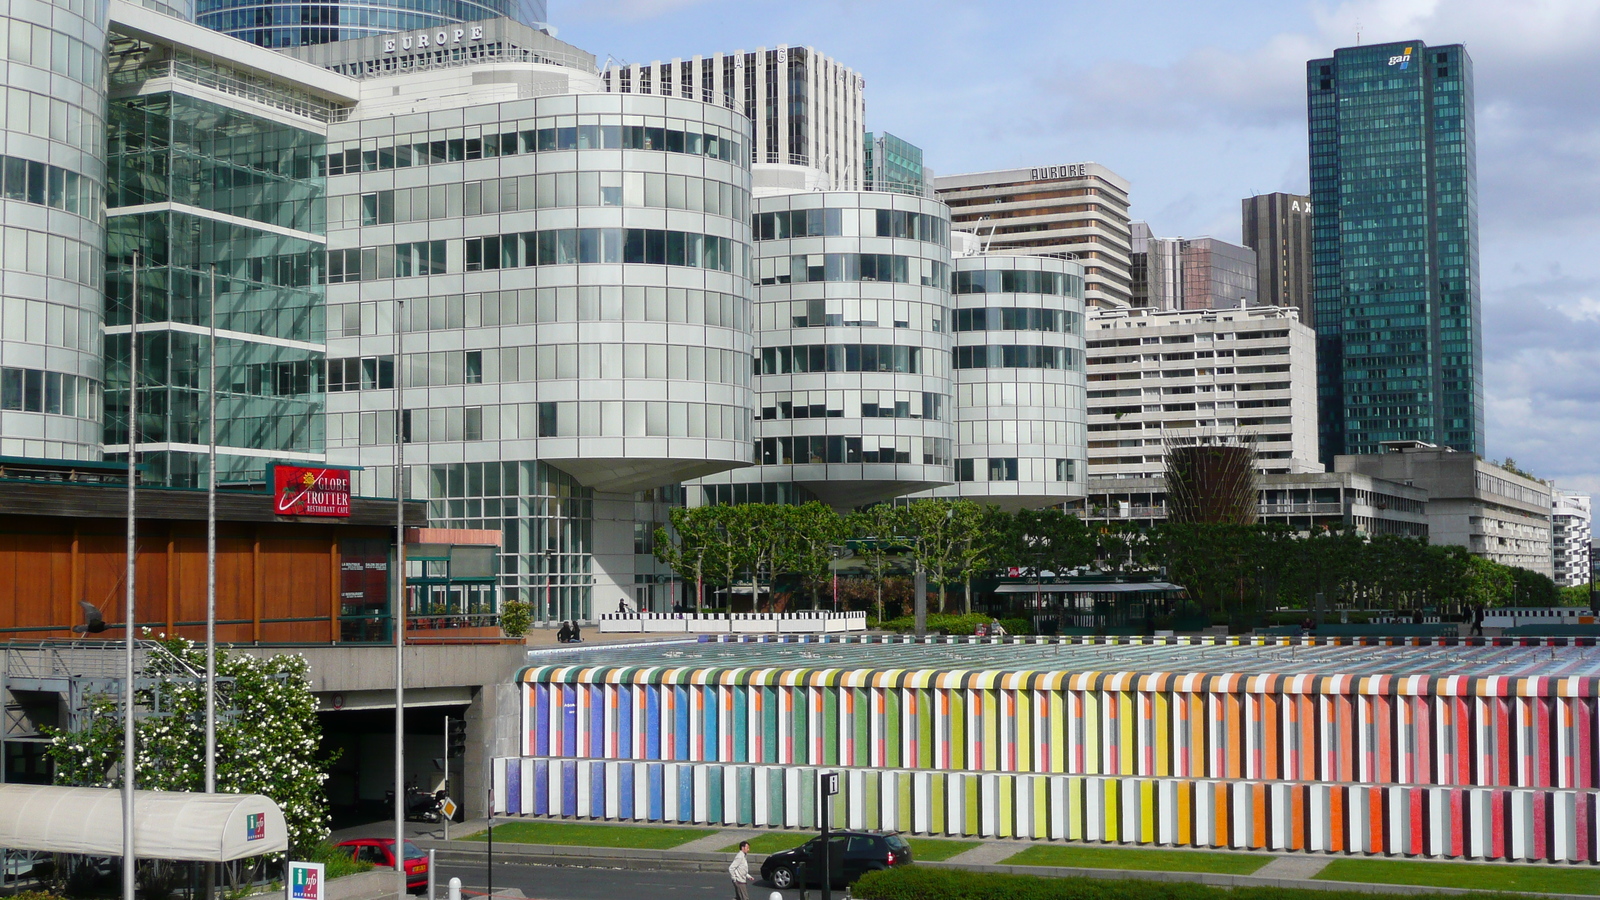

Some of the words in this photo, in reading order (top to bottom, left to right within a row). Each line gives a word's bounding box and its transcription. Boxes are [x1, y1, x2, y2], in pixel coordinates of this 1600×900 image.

[384, 26, 483, 53] EUROPE
[734, 49, 786, 69] AIG
[1388, 55, 1411, 65] gan
[1031, 164, 1086, 180] AURORE
[318, 477, 347, 491] GLOBE
[307, 491, 348, 505] TROTTER
